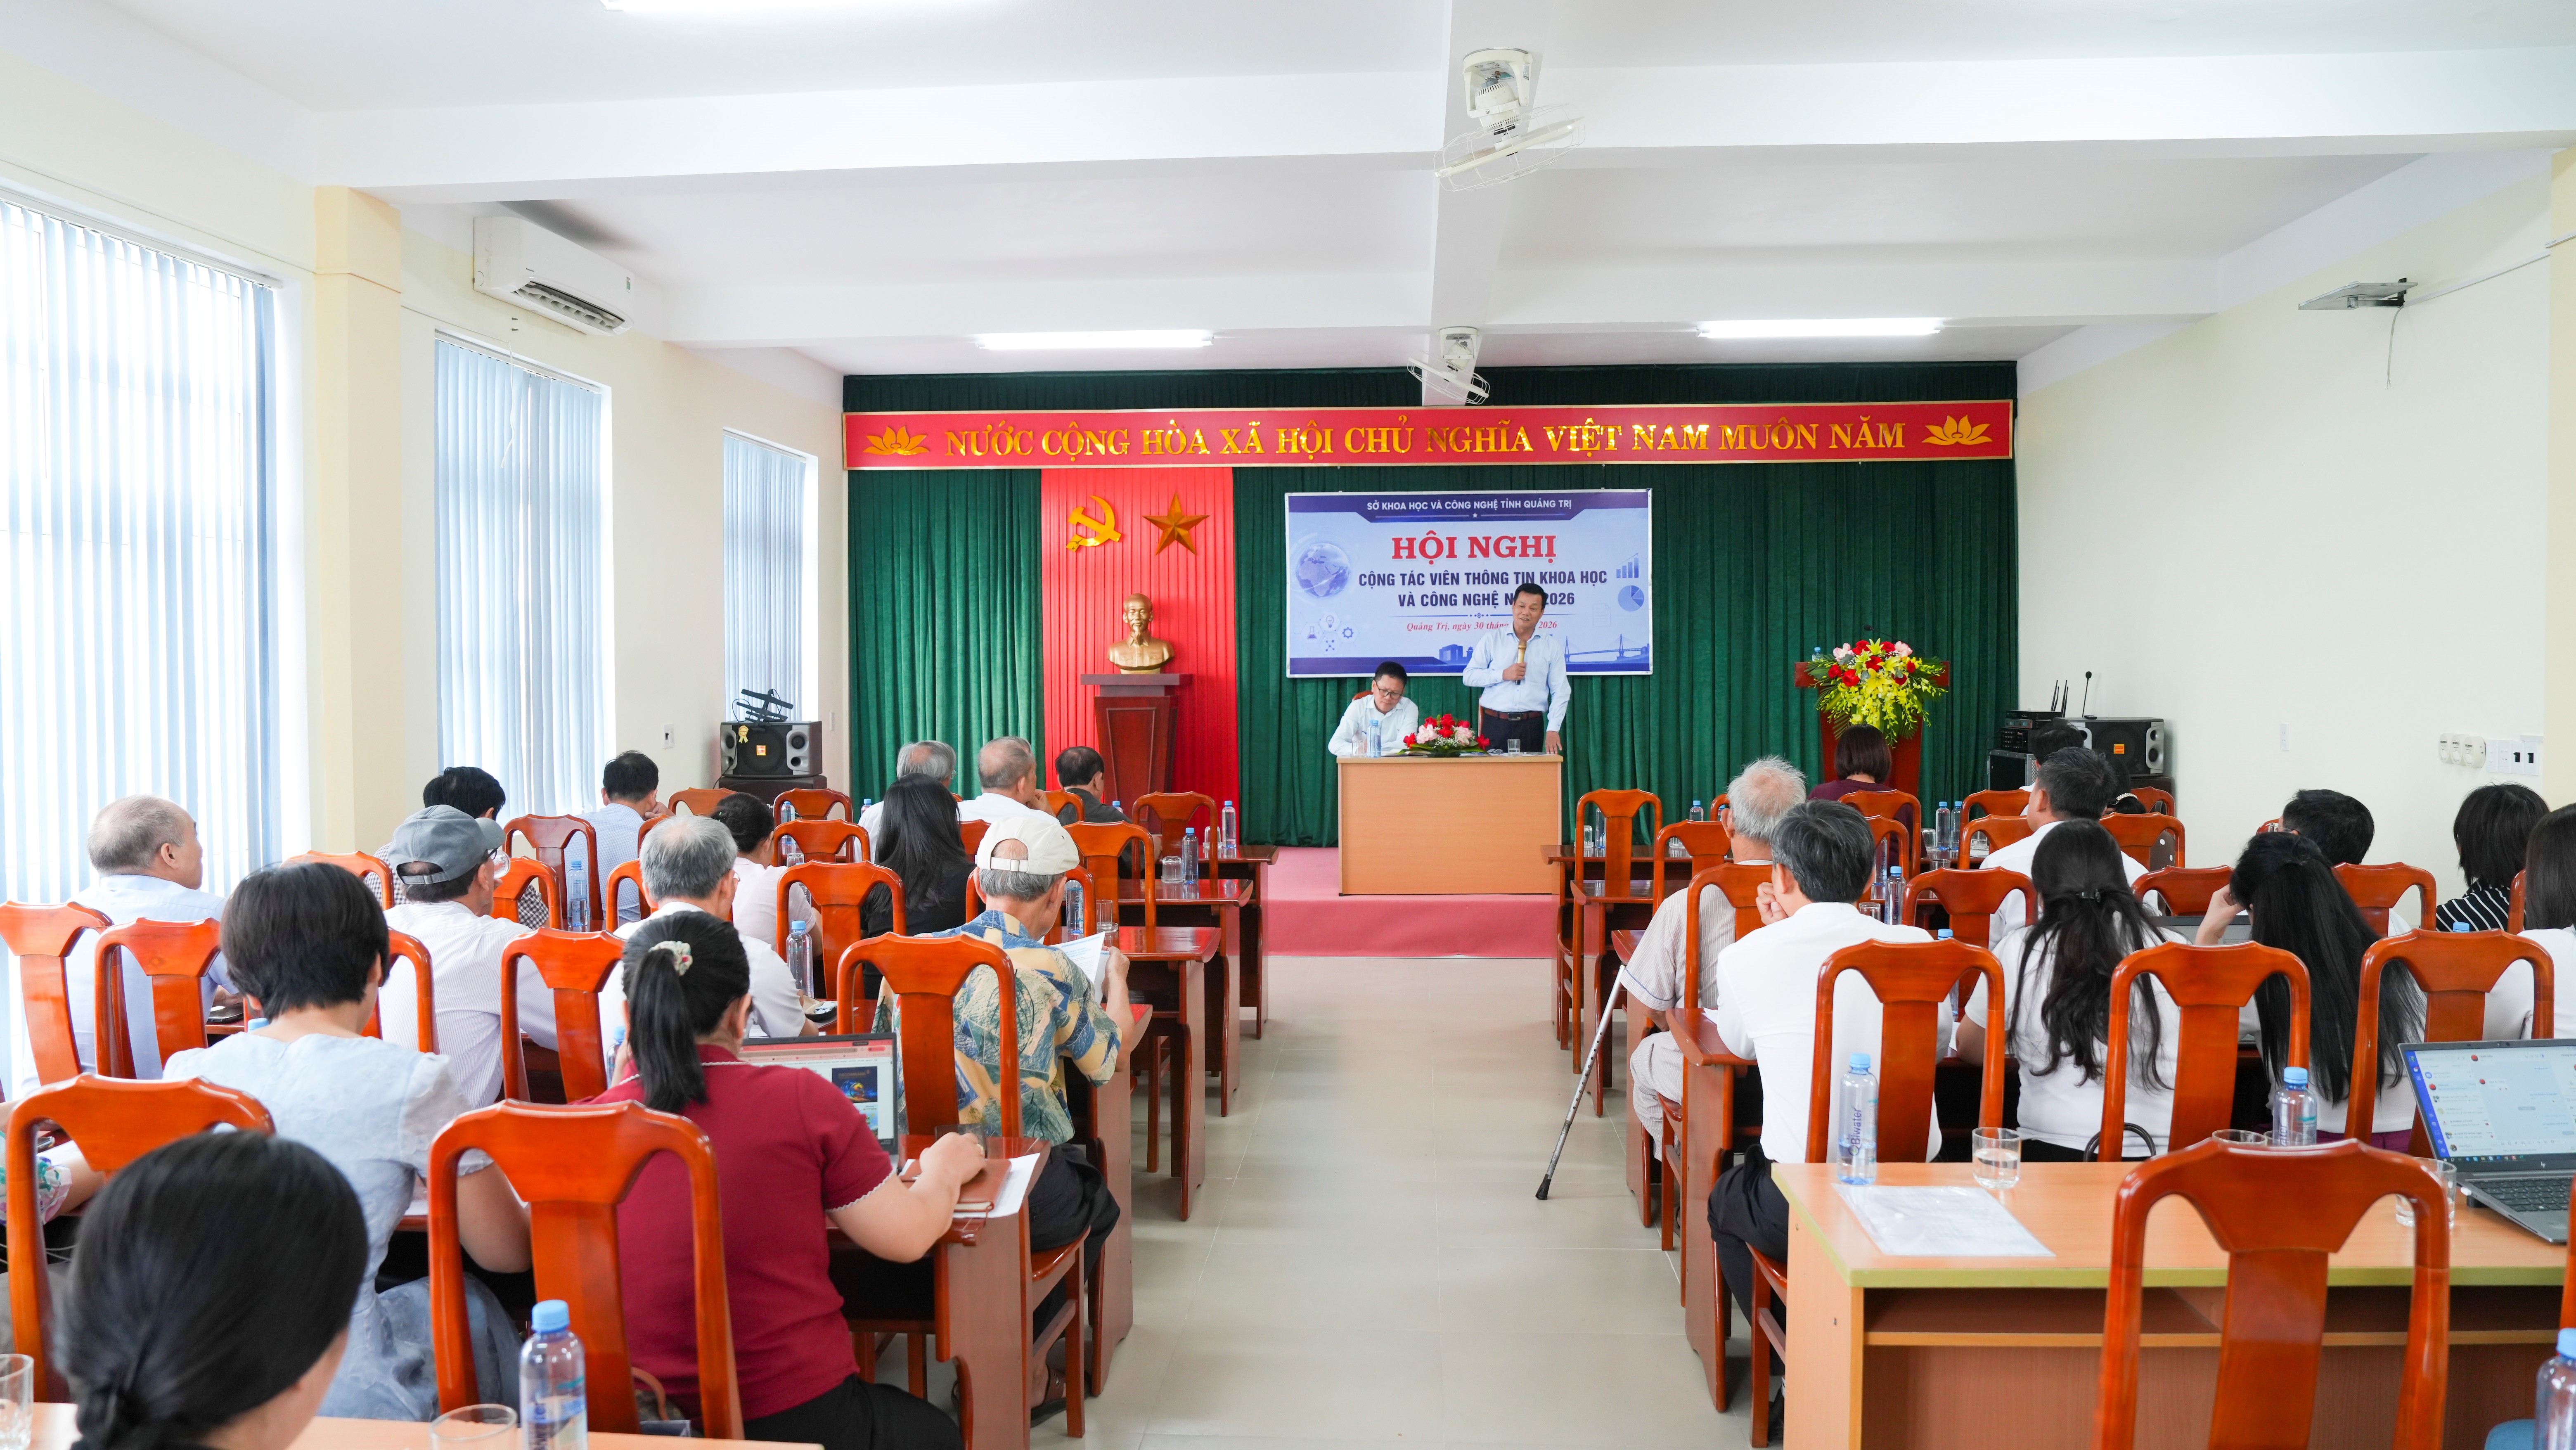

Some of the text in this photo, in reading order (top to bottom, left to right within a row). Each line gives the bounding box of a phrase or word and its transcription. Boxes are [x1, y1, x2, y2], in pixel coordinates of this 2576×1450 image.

[945, 415, 1905, 462] NƯỚC CỘNG HÒA XÃ HỘI CHỦ NGHĨA VIỆT NAM MUÔN NĂM
[1367, 500, 1379, 510] SỞ
[1409, 502, 1428, 512] HỌC
[1430, 500, 1442, 509] VÀ
[1445, 500, 1471, 509] CÔNG
[1474, 499, 1498, 510] NGHỆ
[1501, 498, 1521, 508] TỈNH
[1524, 498, 1556, 508] QUẢNG
[1558, 500, 1572, 509] TRỊ
[1392, 530, 1556, 565] HỘI NGHỊ
[1359, 569, 1607, 589] CỘNG TÁC VIÊN THÔNG TIN KHOA HỌC
[1398, 592, 1416, 607] VÀ
[1421, 591, 1457, 607] CÔNG
[1463, 590, 1499, 608] NGHỆ
[1406, 622, 1433, 632] Quảng
[1436, 622, 1449, 631] Trị,
[1452, 622, 1471, 631] ngày
[1851, 1107, 1861, 1144] Biwater
